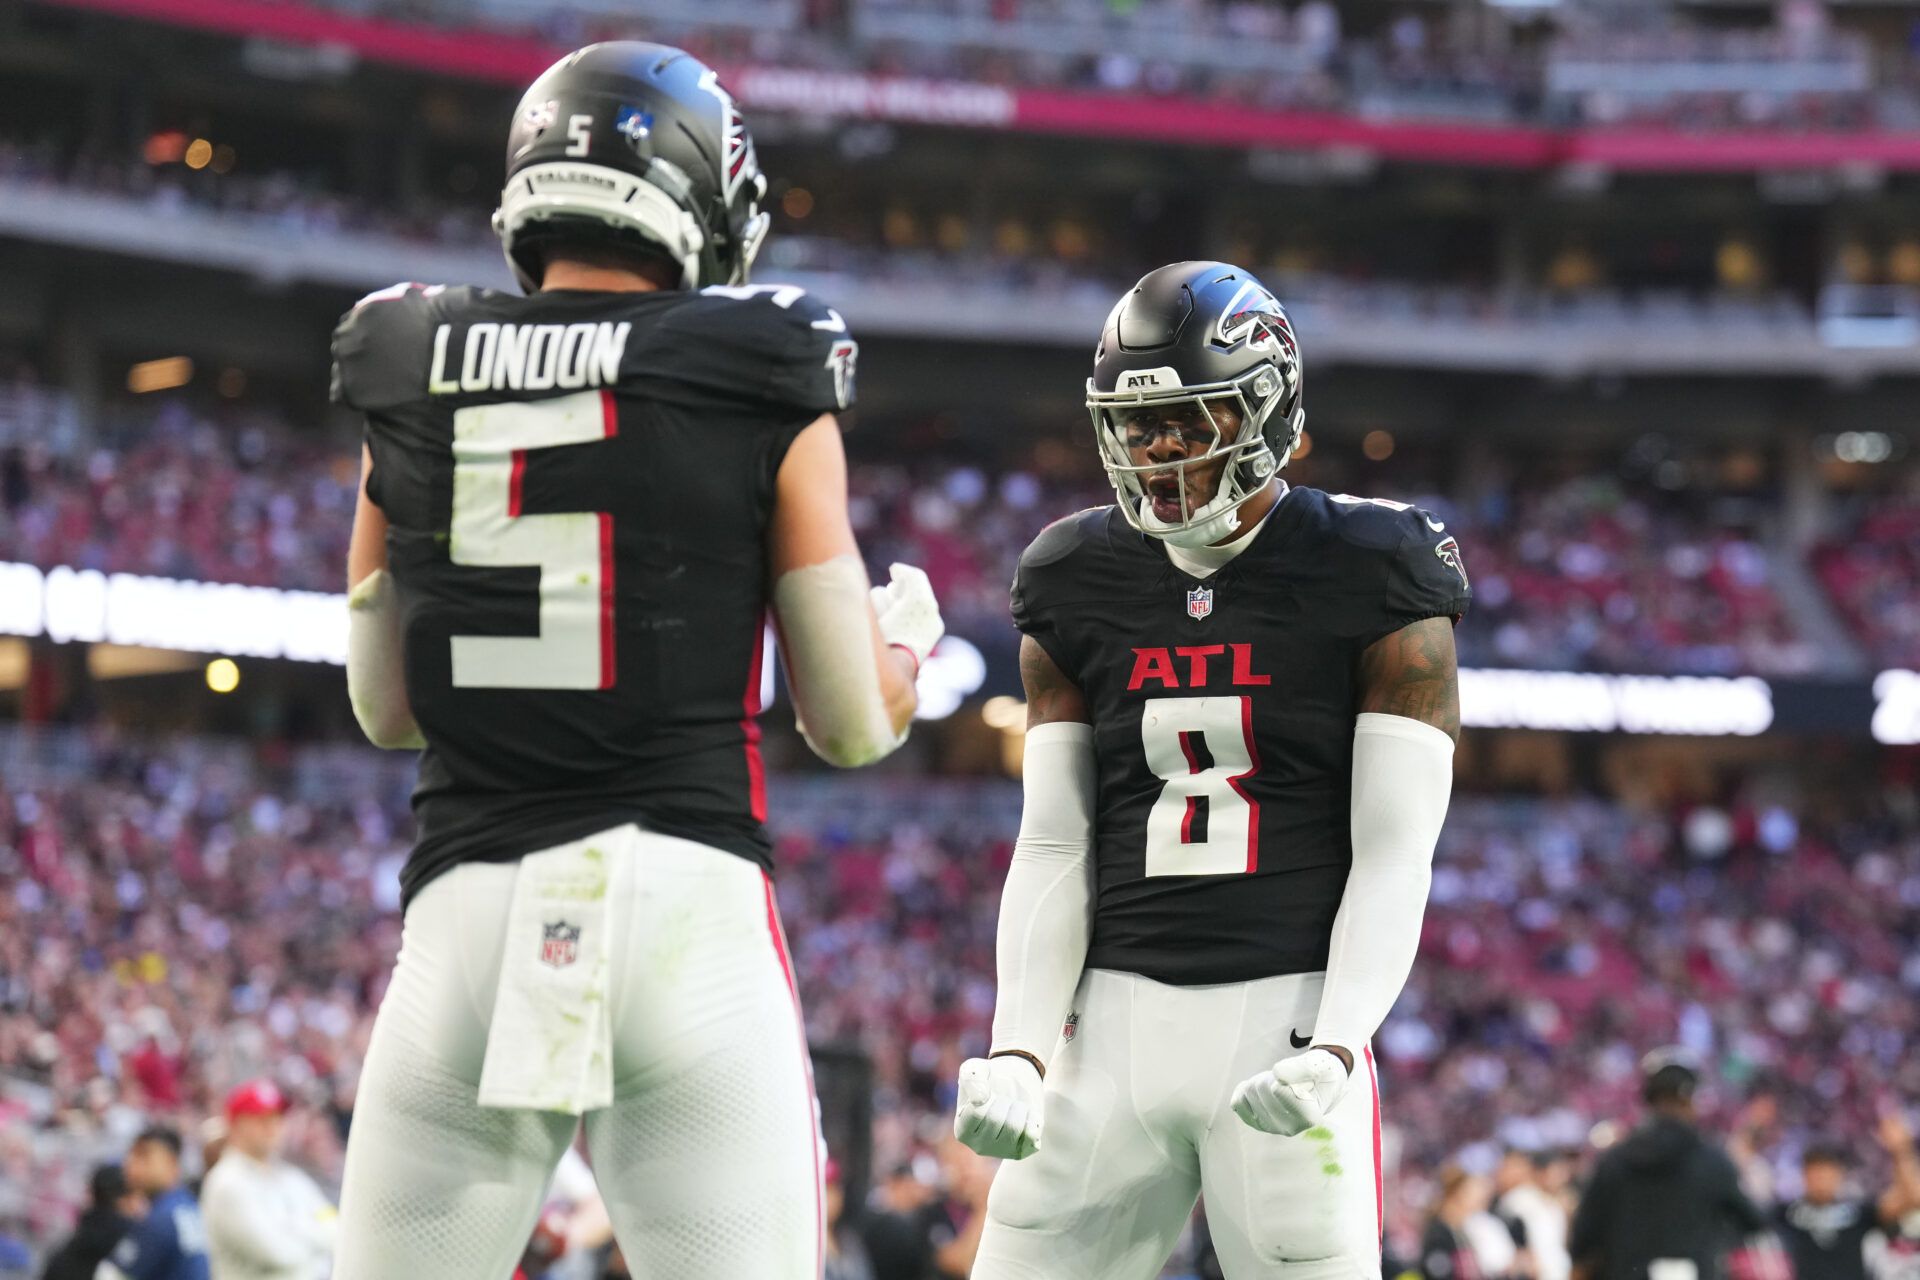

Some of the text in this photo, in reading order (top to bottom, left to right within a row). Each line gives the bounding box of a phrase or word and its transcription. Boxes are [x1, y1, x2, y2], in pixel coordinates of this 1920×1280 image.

[565, 114, 593, 158] 5
[429, 322, 632, 393] LONDON
[1128, 374, 1160, 388] ATL
[450, 389, 618, 690] 5
[1191, 601, 1209, 614] NFL
[1127, 643, 1271, 690] ATL
[1142, 696, 1261, 877] 8
